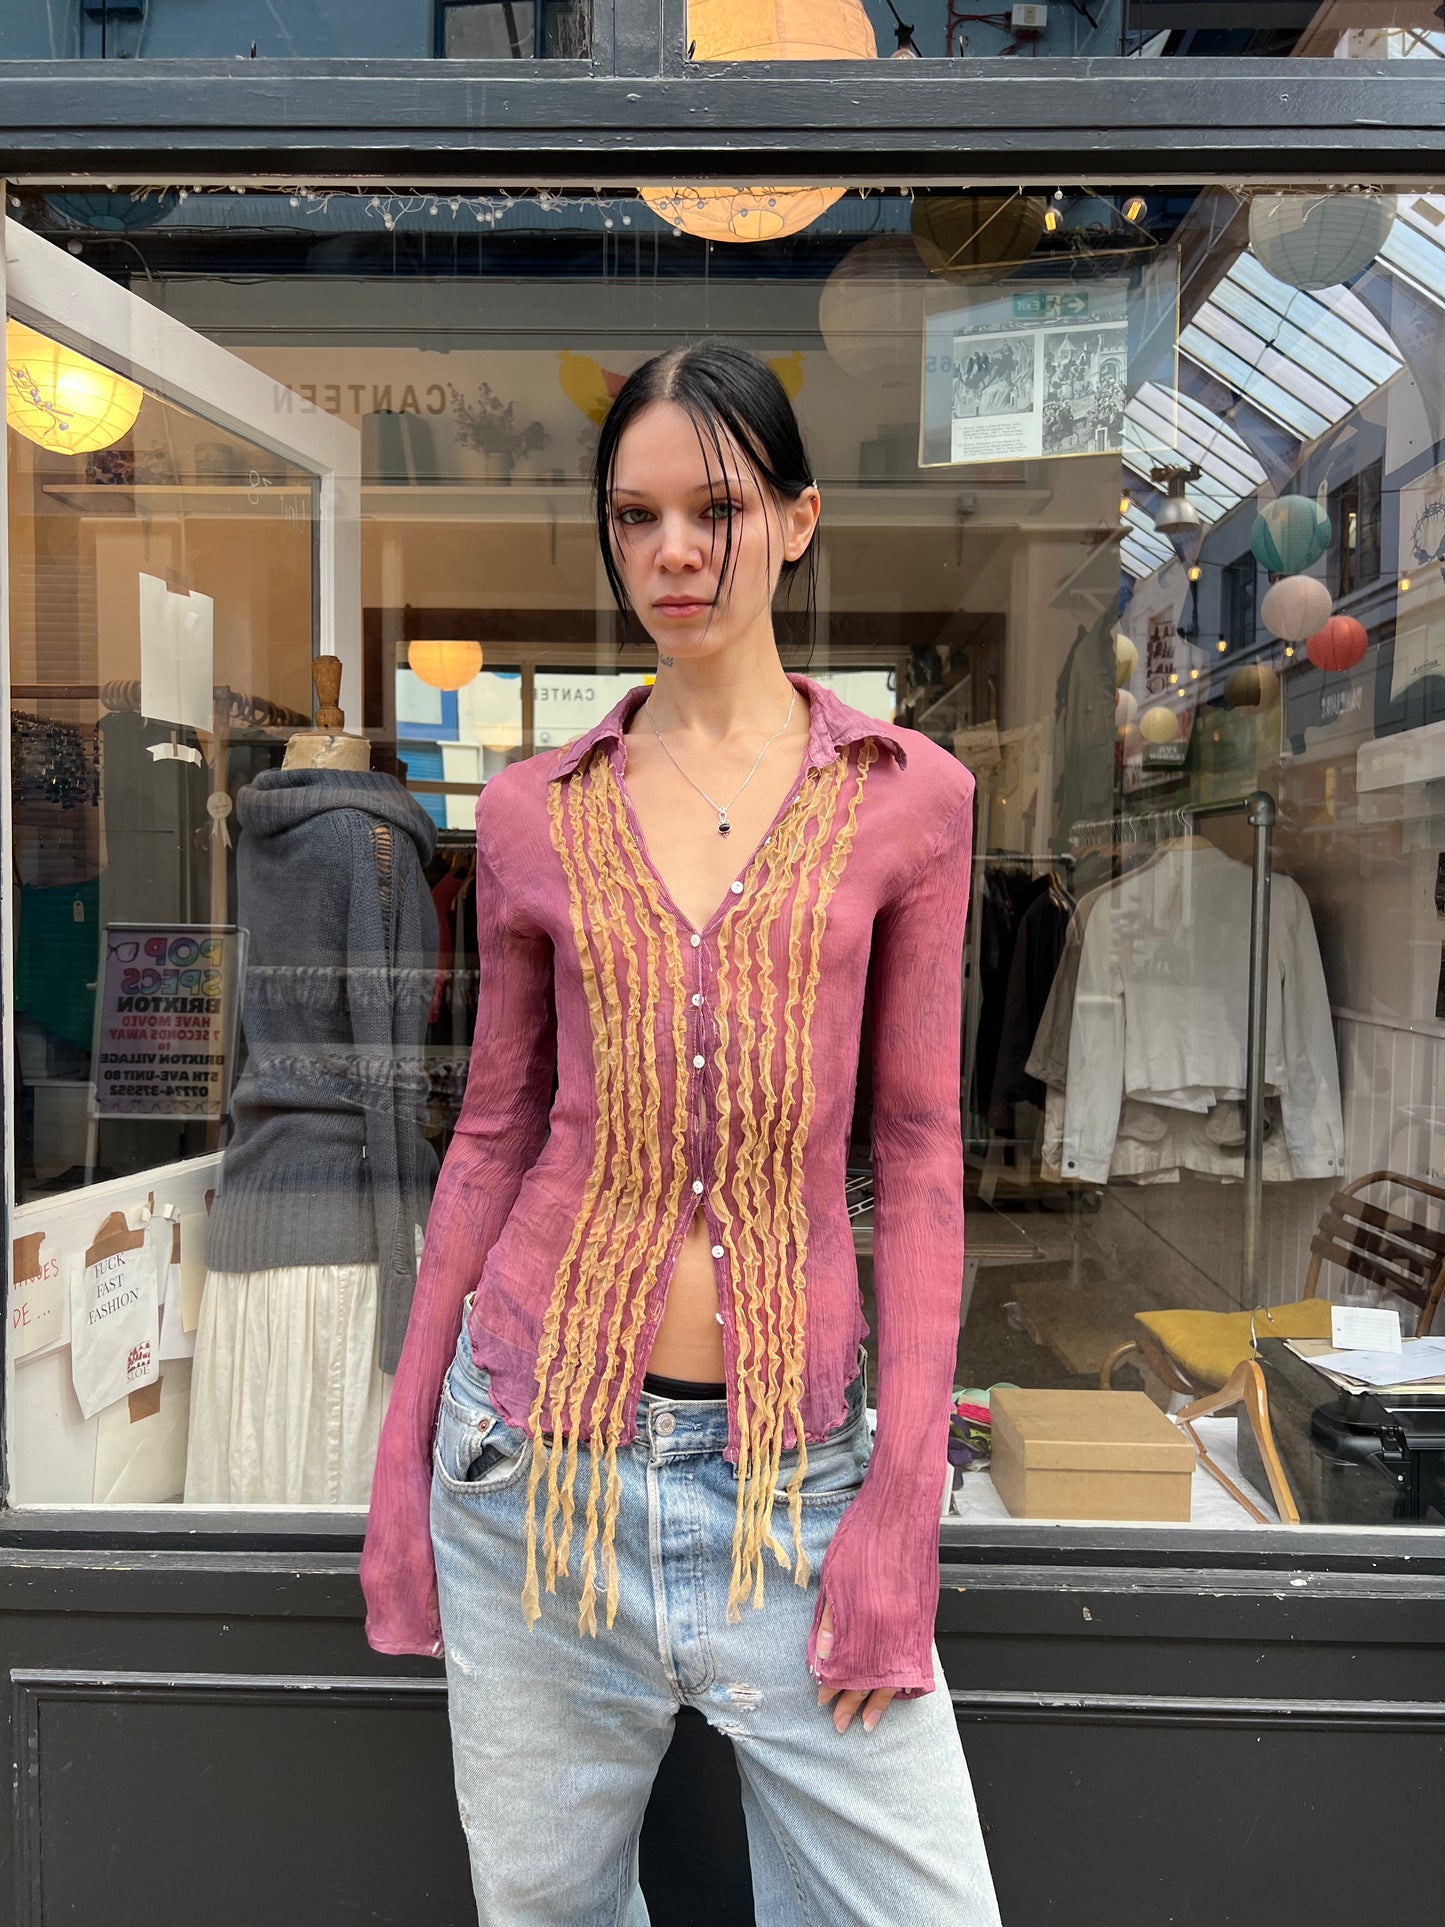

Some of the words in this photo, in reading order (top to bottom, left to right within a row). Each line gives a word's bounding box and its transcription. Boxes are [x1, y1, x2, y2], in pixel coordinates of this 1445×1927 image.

[97, 1273, 124, 1298] FAST
[13, 1302, 31, 1329] DE
[88, 1287, 139, 1325] FASHION
[126, 1366, 150, 1383] SLOE
